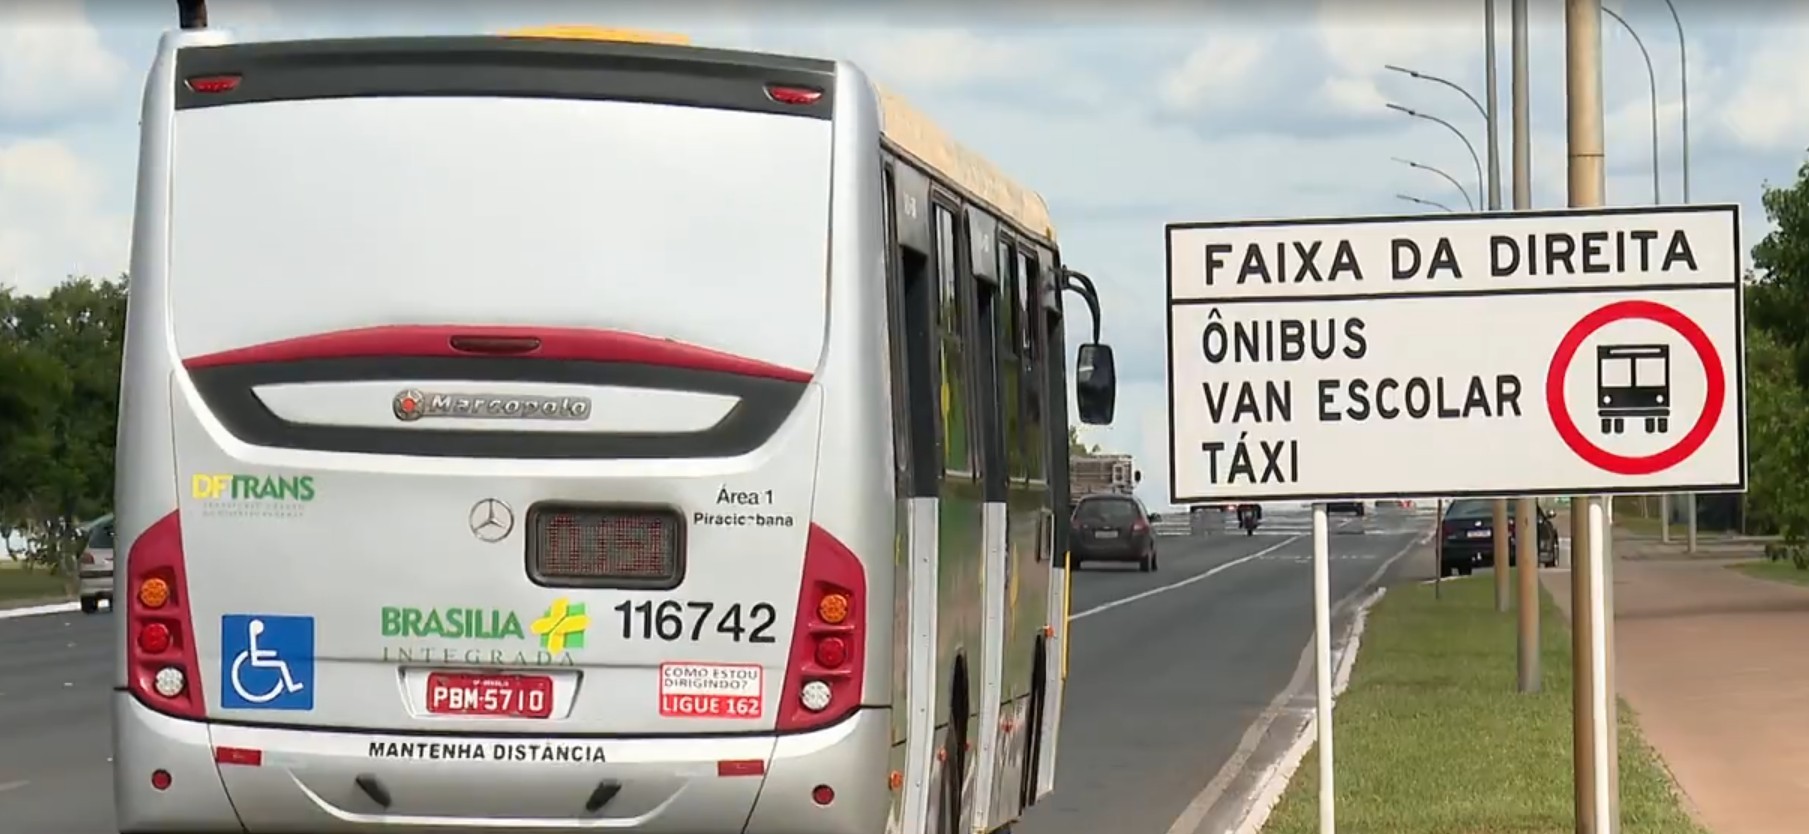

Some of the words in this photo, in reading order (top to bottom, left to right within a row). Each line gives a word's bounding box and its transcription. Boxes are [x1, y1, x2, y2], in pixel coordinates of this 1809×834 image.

[1205, 239, 1363, 286] FAIXA
[1391, 237, 1462, 280] DA
[1490, 229, 1698, 277] DIREITA
[1202, 307, 1367, 364] ÔNIBUS
[429, 394, 588, 419] Marcopolo
[1202, 380, 1291, 424] VAN
[1318, 374, 1521, 421] ESCOLAR
[1201, 431, 1299, 484] TÁXI
[191, 473, 315, 501] DFTRANS
[716, 484, 759, 505] Área
[765, 489, 773, 504] 1
[381, 606, 525, 640] BRASILIA
[614, 600, 776, 643] 116742
[382, 646, 576, 666] INTEGRADA
[664, 667, 708, 678] COMO
[713, 668, 758, 680] ESTOU
[664, 678, 748, 690] DIRIGINDO?
[433, 686, 544, 712] PBM-5710
[663, 695, 720, 714] LIGUE
[726, 698, 760, 715] 162
[369, 742, 485, 760] MANTENHA
